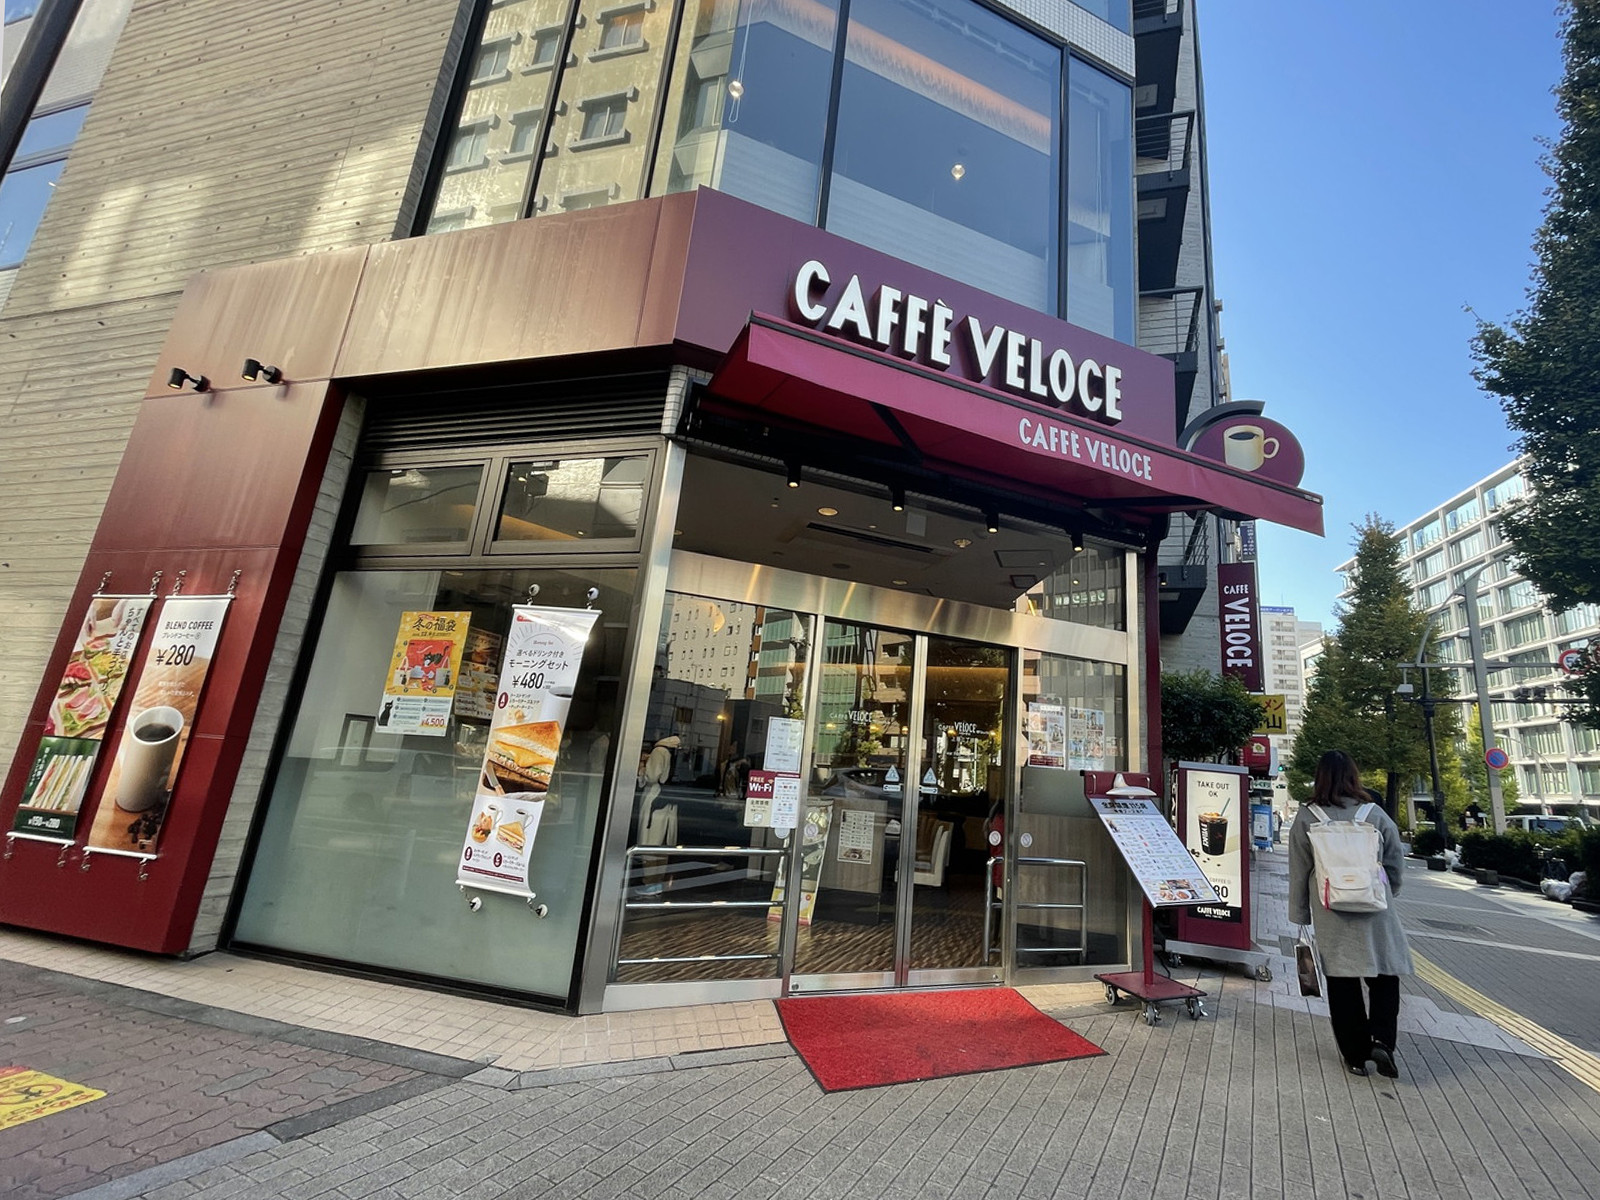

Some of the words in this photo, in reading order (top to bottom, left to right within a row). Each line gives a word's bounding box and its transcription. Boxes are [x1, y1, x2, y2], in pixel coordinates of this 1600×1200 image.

[795, 259, 953, 367] CAFFÈ
[967, 315, 1123, 421] VELOCE
[1018, 417, 1081, 459] CAFFÈ
[1084, 436, 1153, 482] VELOCE
[165, 621, 187, 630] BLEND
[188, 621, 214, 631] COFFEE
[1224, 597, 1253, 668] VELOCE
[155, 644, 196, 666] ¥280
[509, 659, 569, 671] モーニングセット
[512, 672, 545, 689] ¥480
[749, 783, 772, 792] Wi-Fi
[1197, 780, 1214, 789] TAKE
[1215, 782, 1230, 790] OUT
